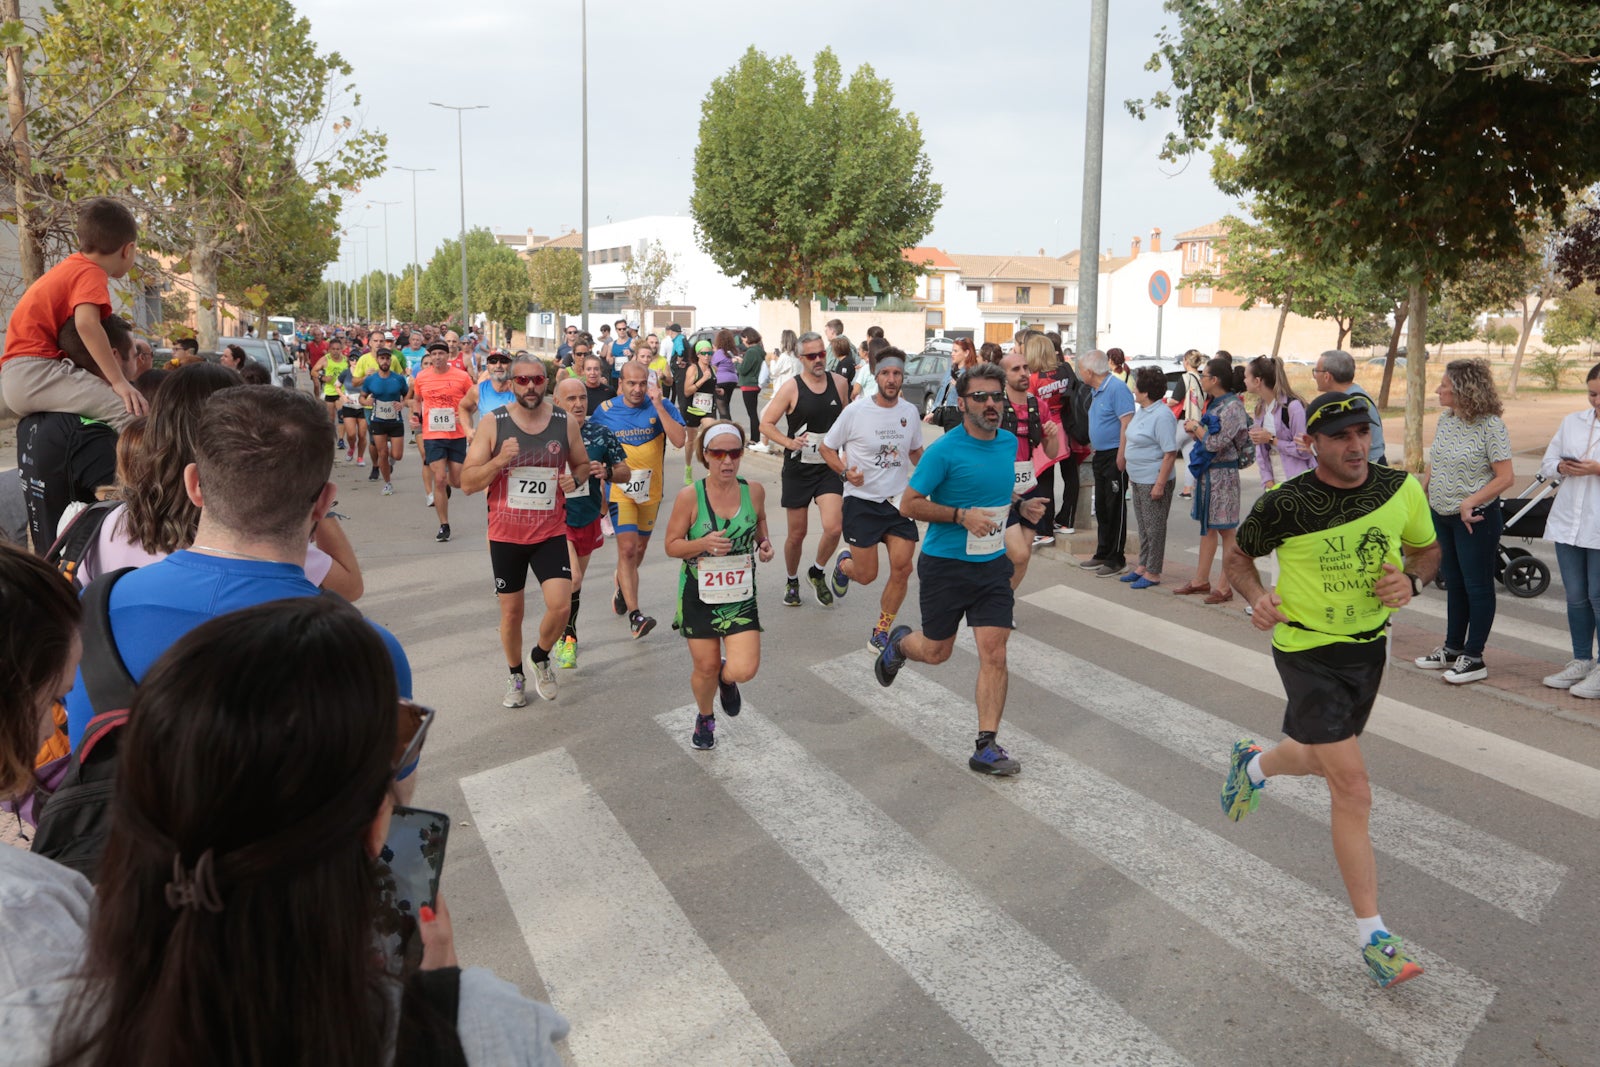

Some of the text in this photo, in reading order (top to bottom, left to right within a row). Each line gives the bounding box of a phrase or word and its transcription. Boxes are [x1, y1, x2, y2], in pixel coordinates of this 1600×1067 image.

[542, 314, 550, 324] P
[615, 428, 654, 437] agustinos
[519, 480, 546, 494] 720
[626, 481, 645, 492] 207
[1323, 536, 1346, 554] XI
[1320, 553, 1351, 563] Prueba
[1321, 561, 1352, 571] Fondo
[705, 570, 745, 587] 2167
